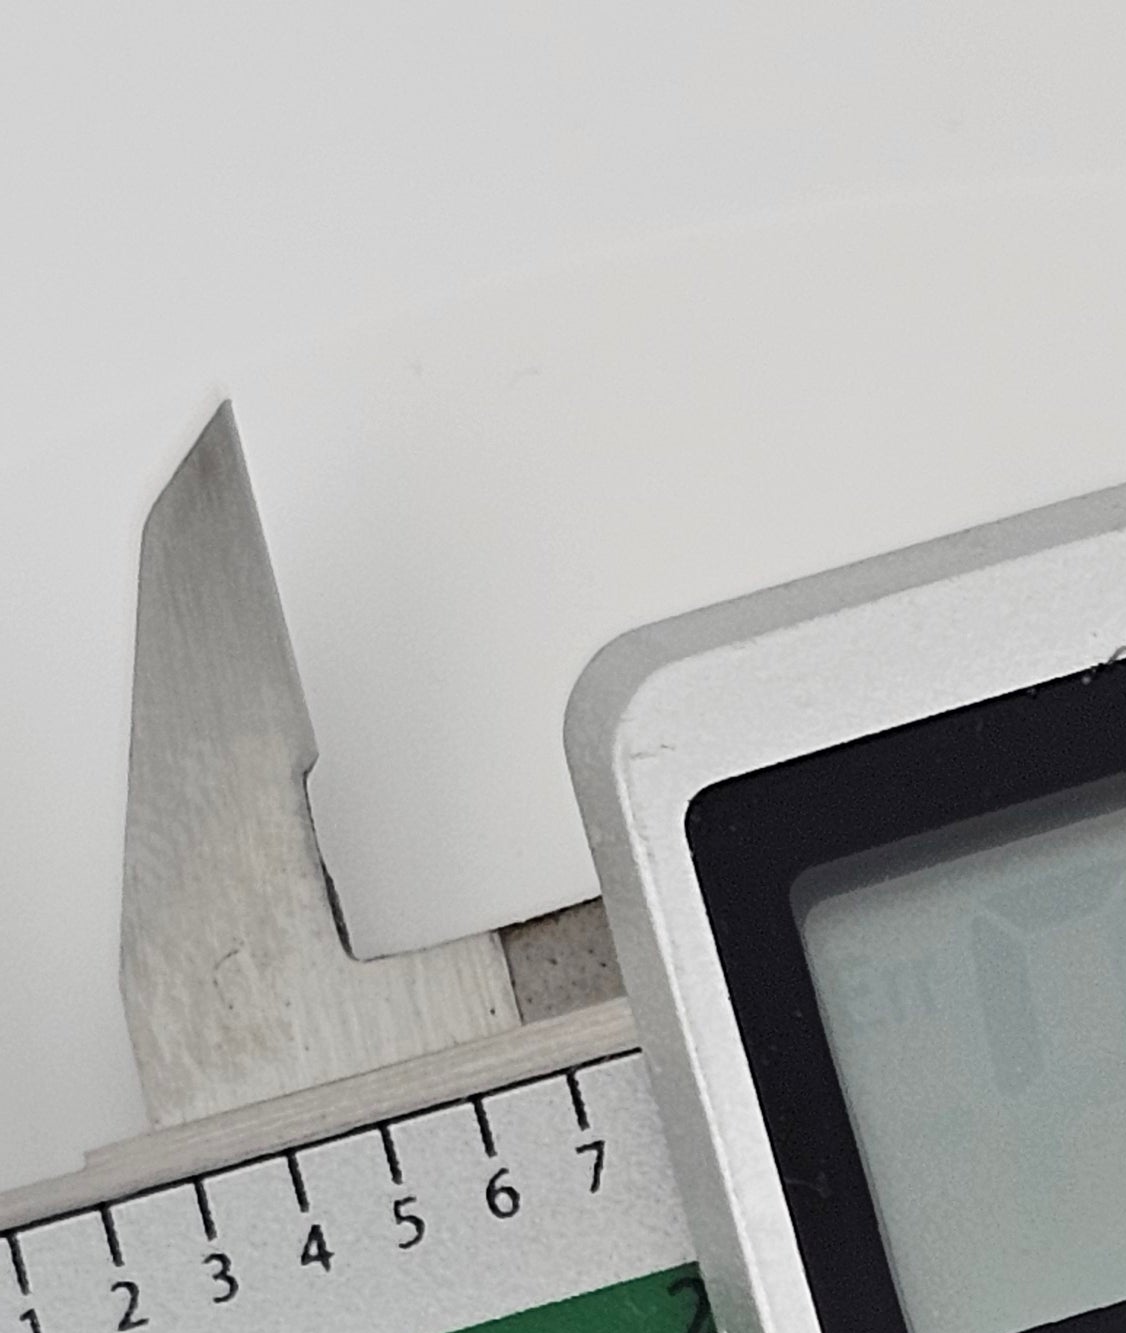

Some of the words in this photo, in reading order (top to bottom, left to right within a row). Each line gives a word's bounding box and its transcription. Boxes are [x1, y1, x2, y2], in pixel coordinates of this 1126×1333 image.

[110, 1281, 149, 1332] 2
[203, 1253, 239, 1304] 3
[300, 1224, 335, 1272] 4
[393, 1196, 426, 1250] 5
[485, 1167, 521, 1219] 6
[575, 1139, 606, 1194] 7
